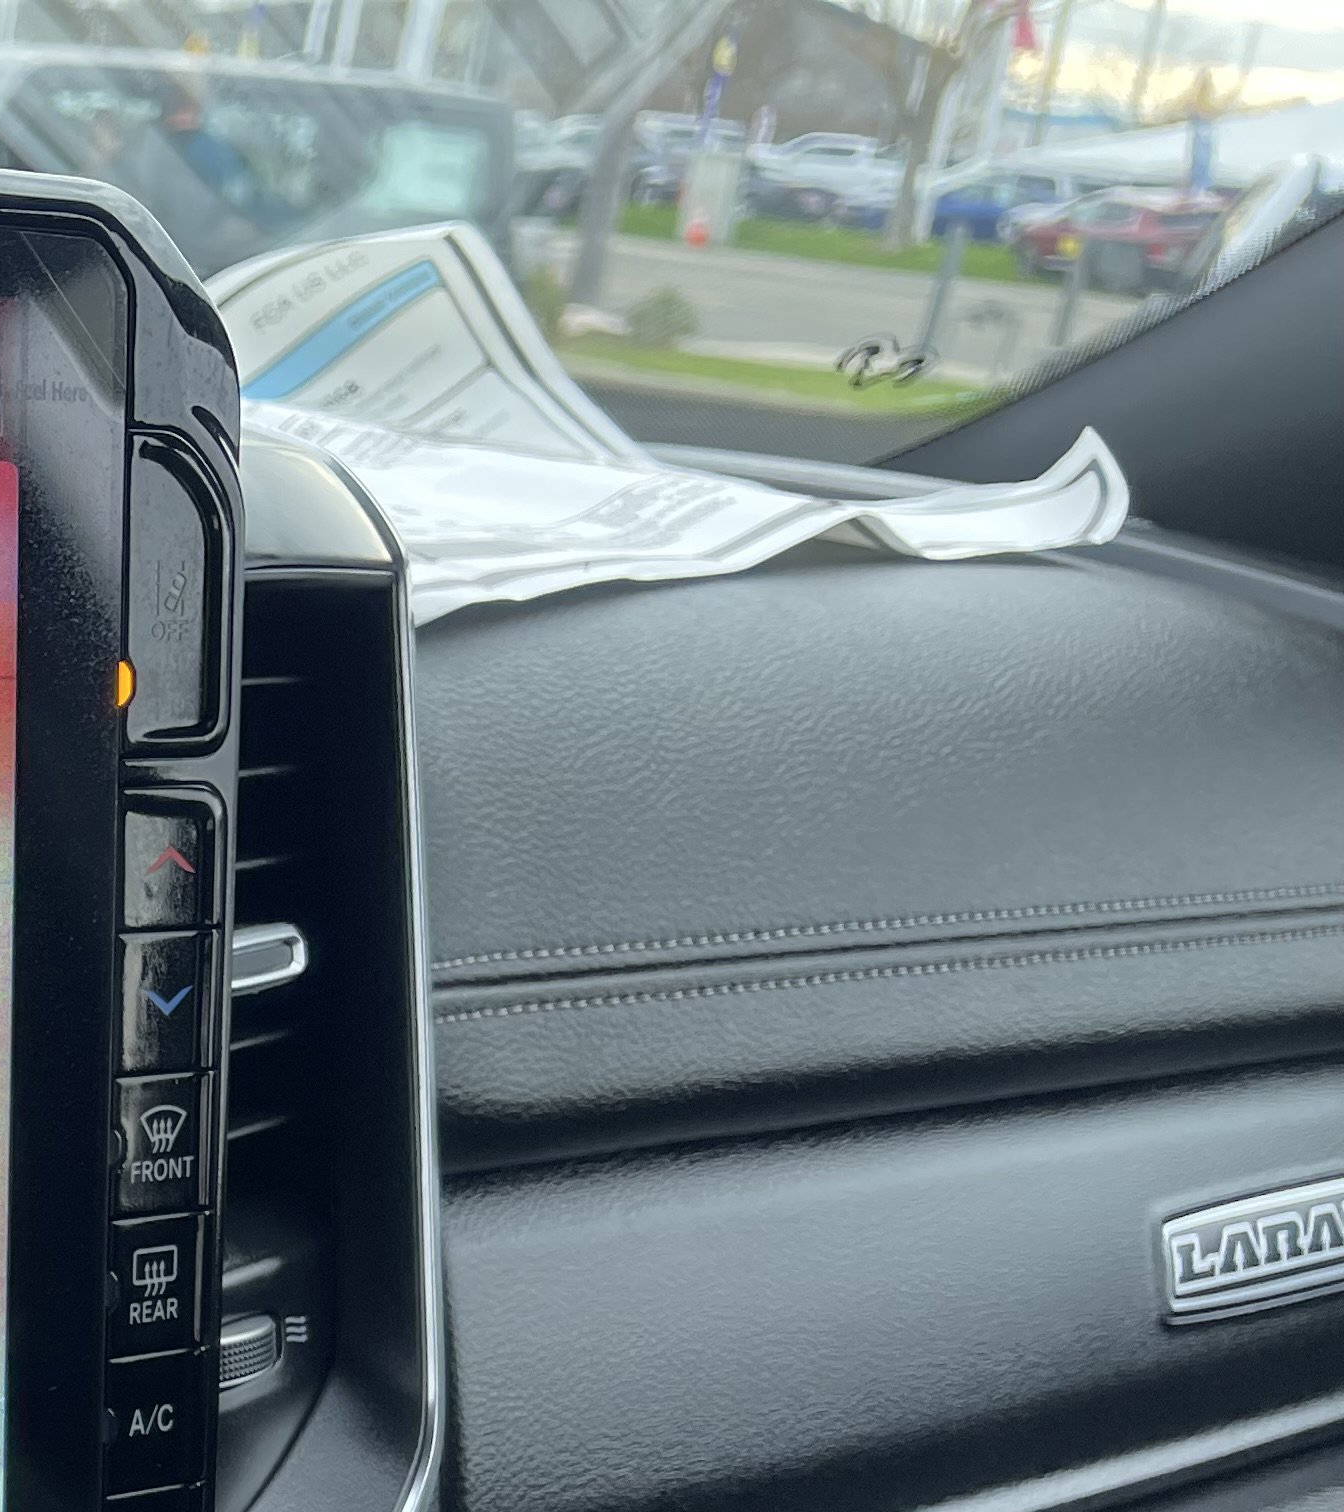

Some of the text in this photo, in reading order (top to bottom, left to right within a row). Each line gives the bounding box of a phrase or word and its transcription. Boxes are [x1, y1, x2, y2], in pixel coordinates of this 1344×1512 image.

[52, 380, 89, 402] Here
[150, 620, 189, 642] OFF
[130, 1155, 194, 1184] FRONT
[1171, 1200, 1344, 1297] LARA
[128, 1297, 179, 1325] REAR
[128, 1403, 174, 1438] A/C
